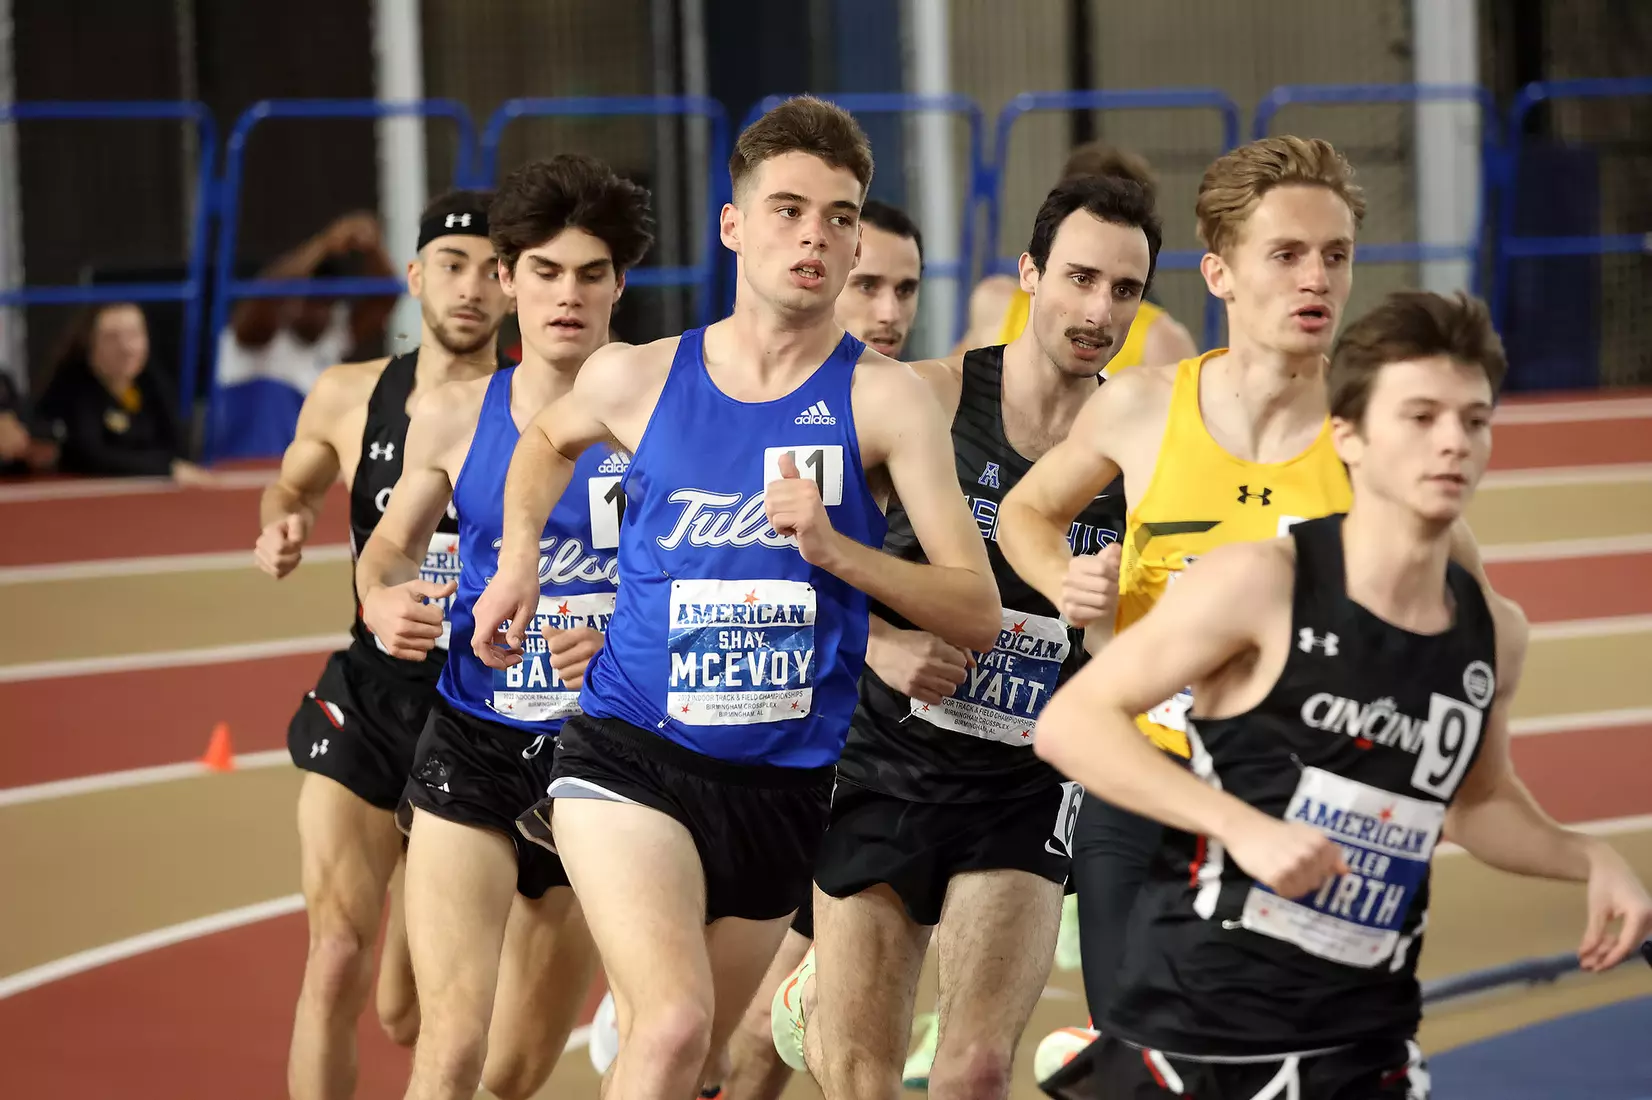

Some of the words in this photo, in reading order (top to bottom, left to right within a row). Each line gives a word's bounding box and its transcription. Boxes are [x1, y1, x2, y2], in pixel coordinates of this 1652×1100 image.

[795, 414, 836, 425] adidas
[598, 463, 628, 473] adid
[978, 461, 1000, 489] A
[656, 487, 799, 550] Tuls
[498, 613, 613, 632] AERICAN
[677, 603, 806, 625] AMERICAN
[719, 631, 765, 650] SHAY
[995, 629, 1063, 659] RICAN
[671, 650, 814, 687] MCEVOY
[742, 693, 758, 701] FIELD
[759, 690, 803, 700] CHAMPIONSHIPS
[968, 667, 1045, 714] YATT
[944, 708, 979, 723] BIRMINGHAM
[978, 716, 1010, 730] CROSSPLEX
[955, 701, 974, 713] TRACK
[979, 707, 995, 717] FIELD
[994, 711, 1037, 729] CHAMPIONSHIPS
[1428, 707, 1466, 787] 9
[1064, 783, 1083, 846] 6
[1296, 797, 1427, 853] AMERICAN
[1342, 844, 1391, 878] YLER
[1314, 869, 1406, 926] IRTH
